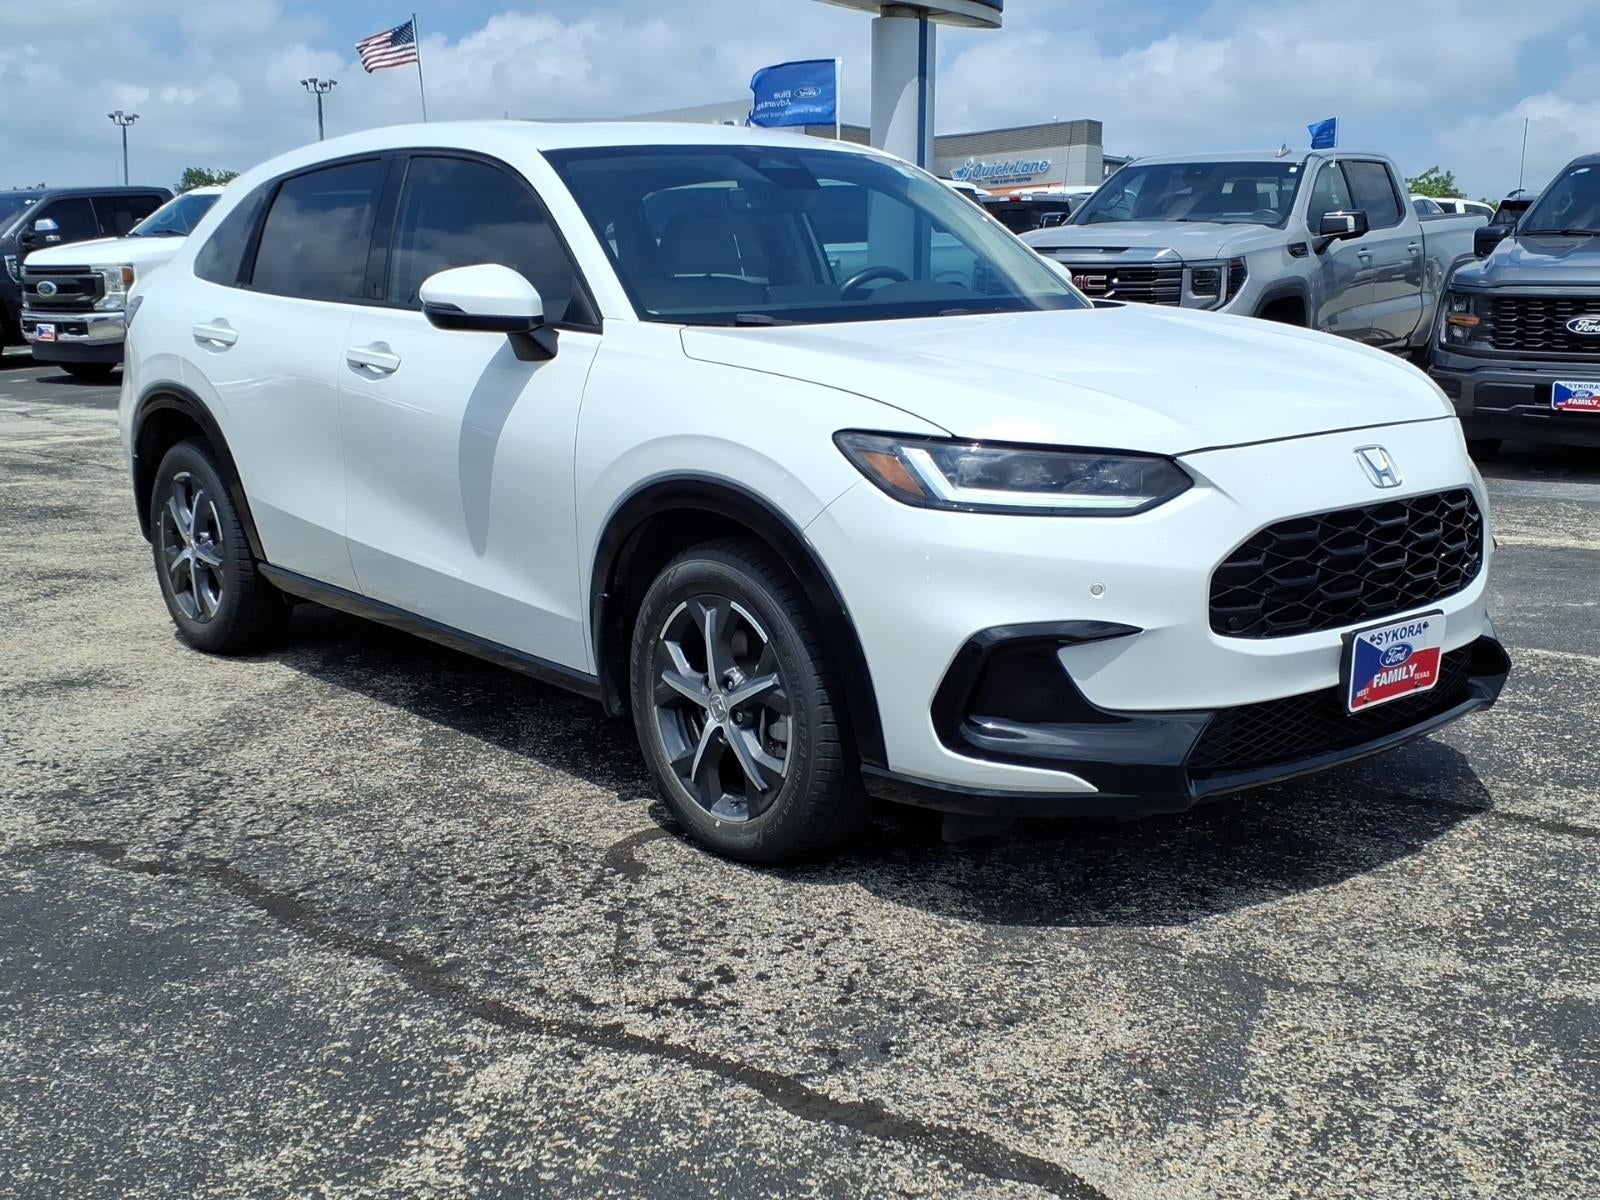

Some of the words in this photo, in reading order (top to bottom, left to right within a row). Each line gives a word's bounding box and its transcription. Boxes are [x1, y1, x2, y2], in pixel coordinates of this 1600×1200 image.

[972, 161, 1010, 179] Quick
[1012, 160, 1049, 174] Lane
[1073, 275, 1107, 290] MC
[1567, 398, 1599, 406] FAMILY
[1376, 623, 1422, 646] SYKORA
[1385, 646, 1408, 664] Ford
[1373, 663, 1418, 688] FAMILY
[1414, 671, 1430, 680] TEXAS
